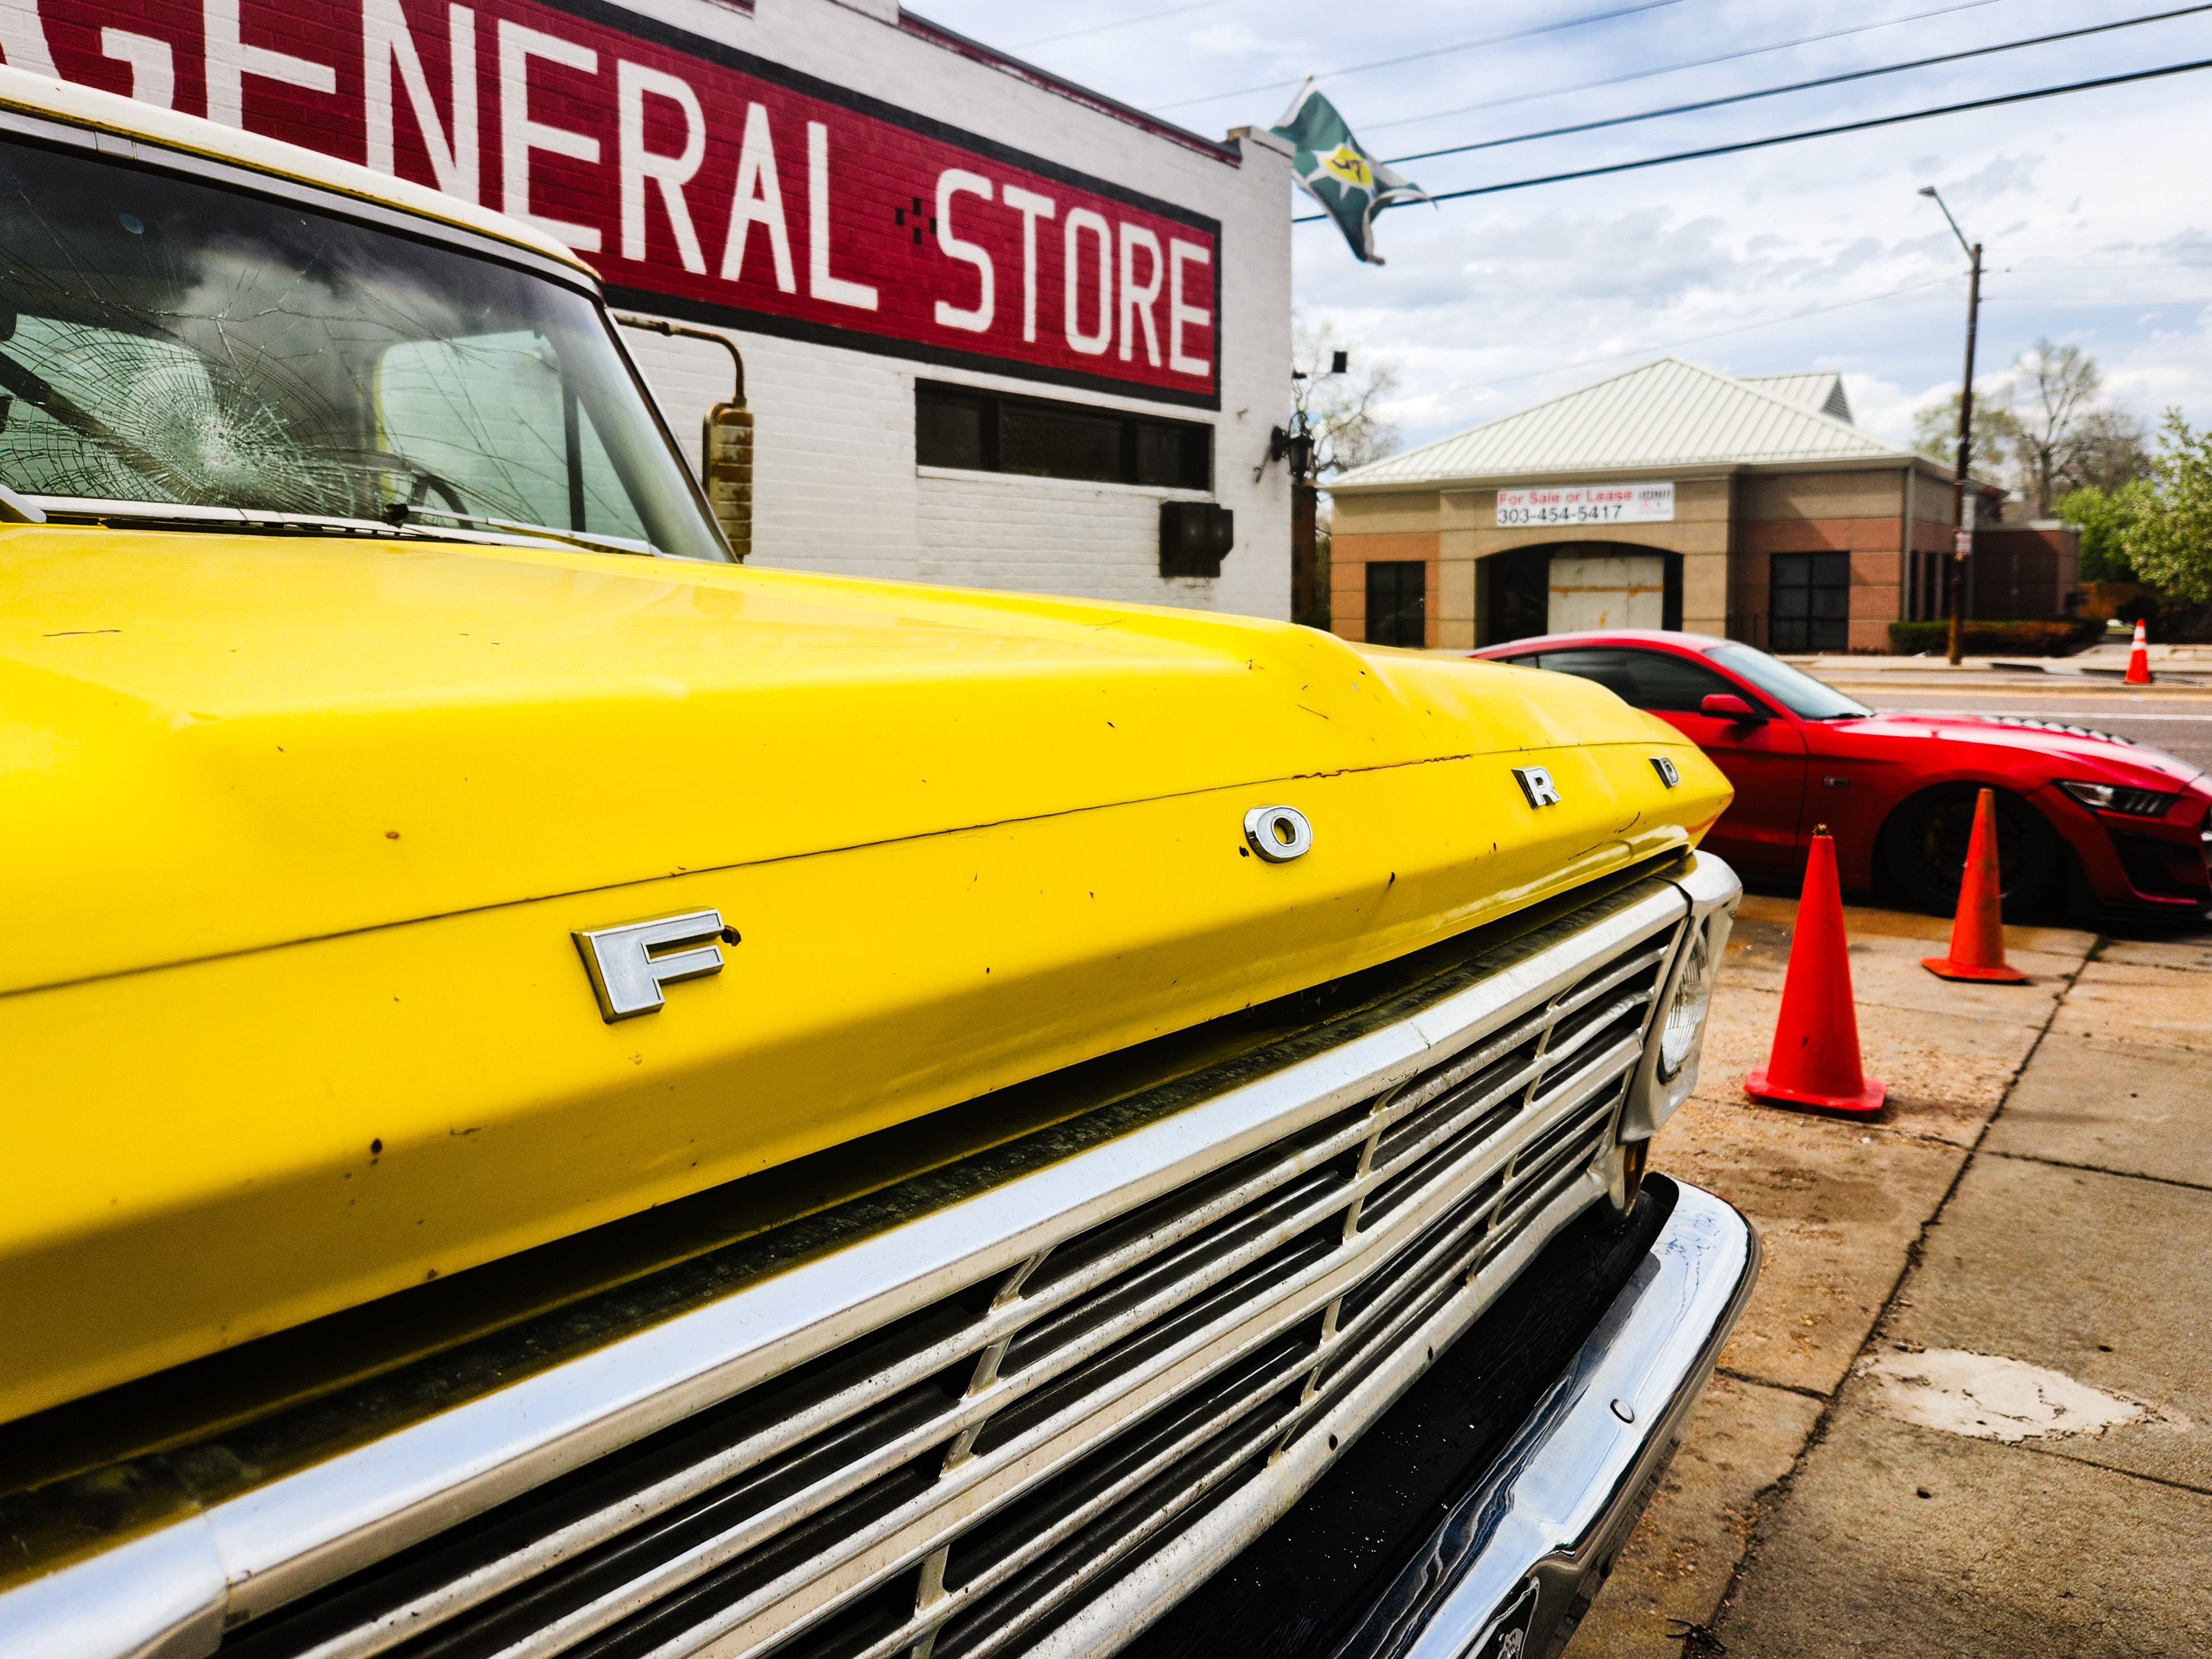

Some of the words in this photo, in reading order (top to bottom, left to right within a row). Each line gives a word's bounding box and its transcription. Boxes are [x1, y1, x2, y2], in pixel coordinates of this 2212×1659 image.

[934, 167, 1211, 377] STORE
[1499, 490, 1523, 506] For
[1528, 490, 1560, 505] Sale
[1565, 491, 1581, 503] or
[1586, 489, 1632, 503] Lease
[1498, 505, 1622, 524] 303-454-5417
